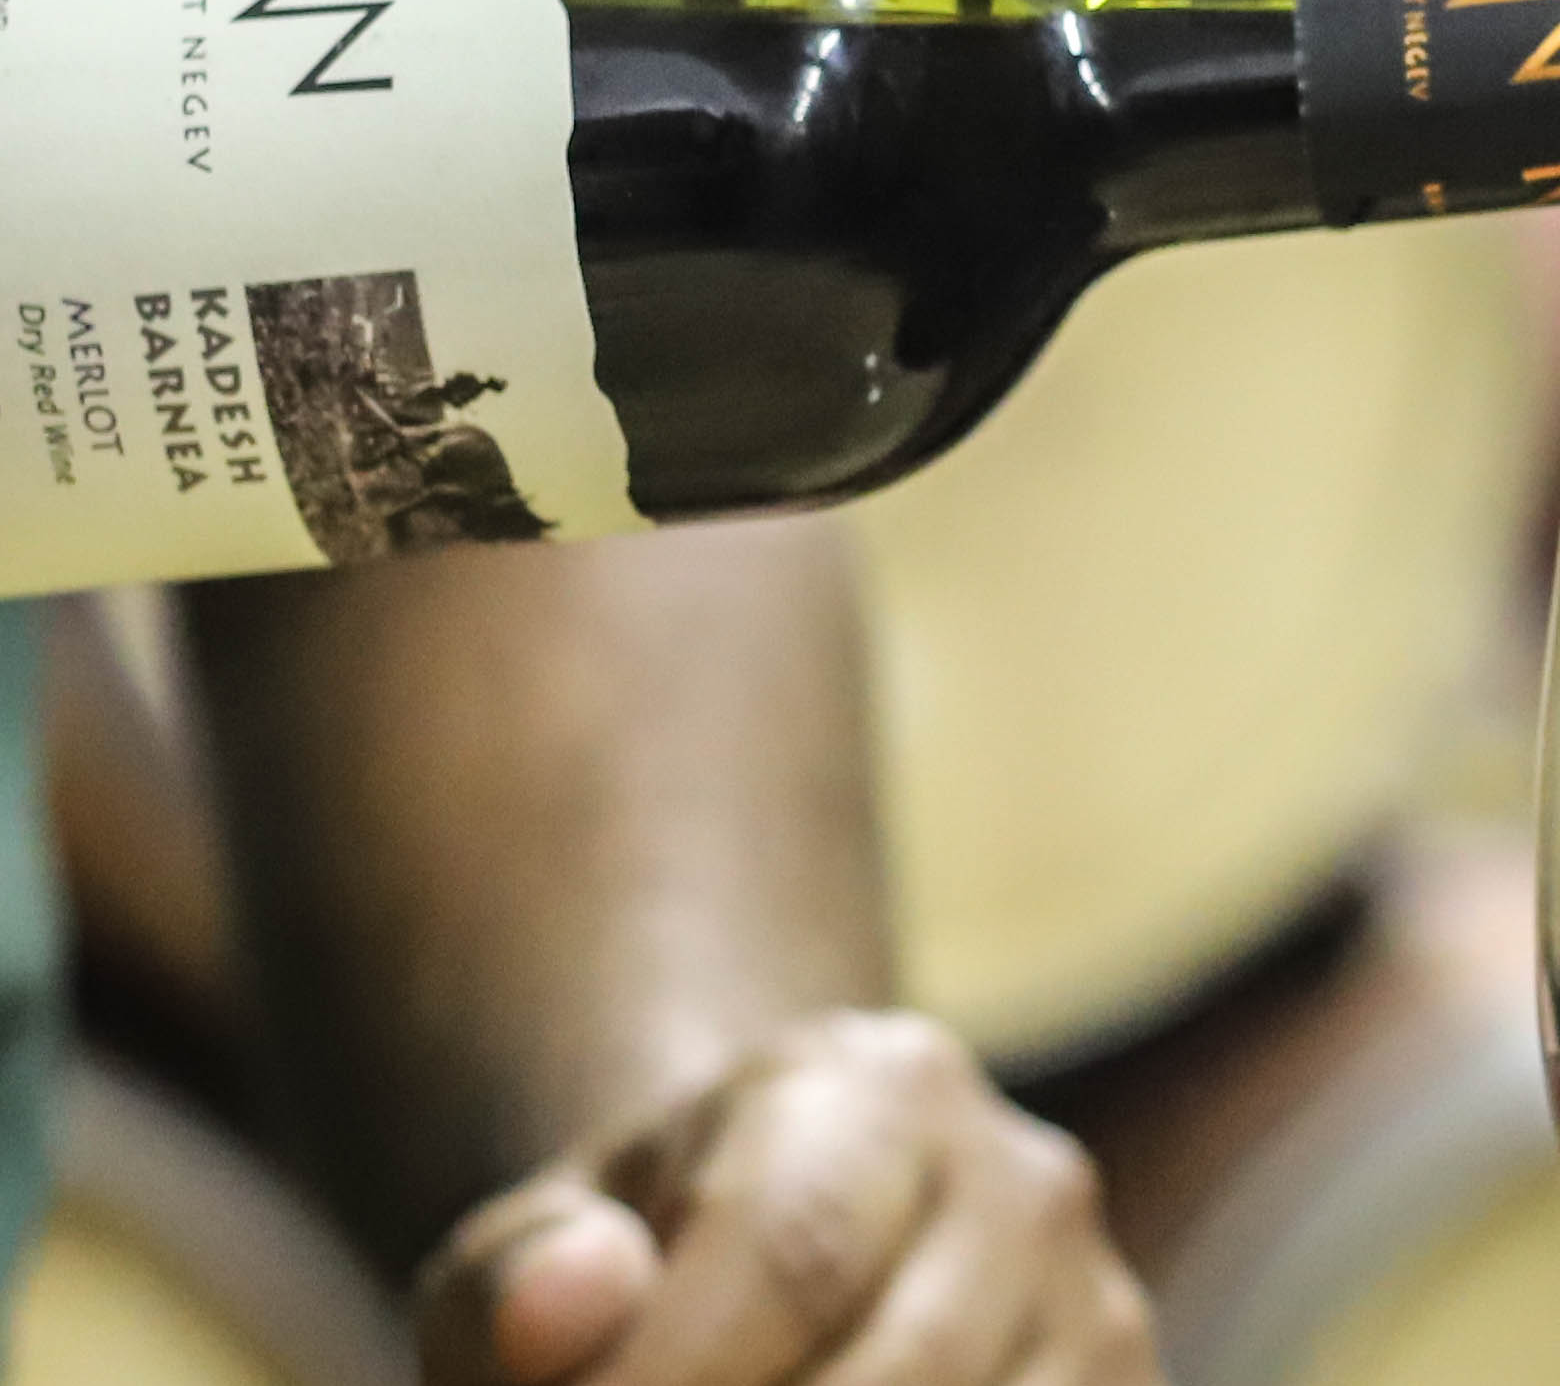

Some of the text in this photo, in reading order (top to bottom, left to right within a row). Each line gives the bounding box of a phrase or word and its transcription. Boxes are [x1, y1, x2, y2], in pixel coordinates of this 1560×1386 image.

[181, 36, 212, 174] NEGEV
[17, 302, 76, 486] Dry Red Wine
[61, 297, 125, 456] MERLOT
[134, 291, 209, 494] BARNEA
[190, 286, 268, 485] KADESH
